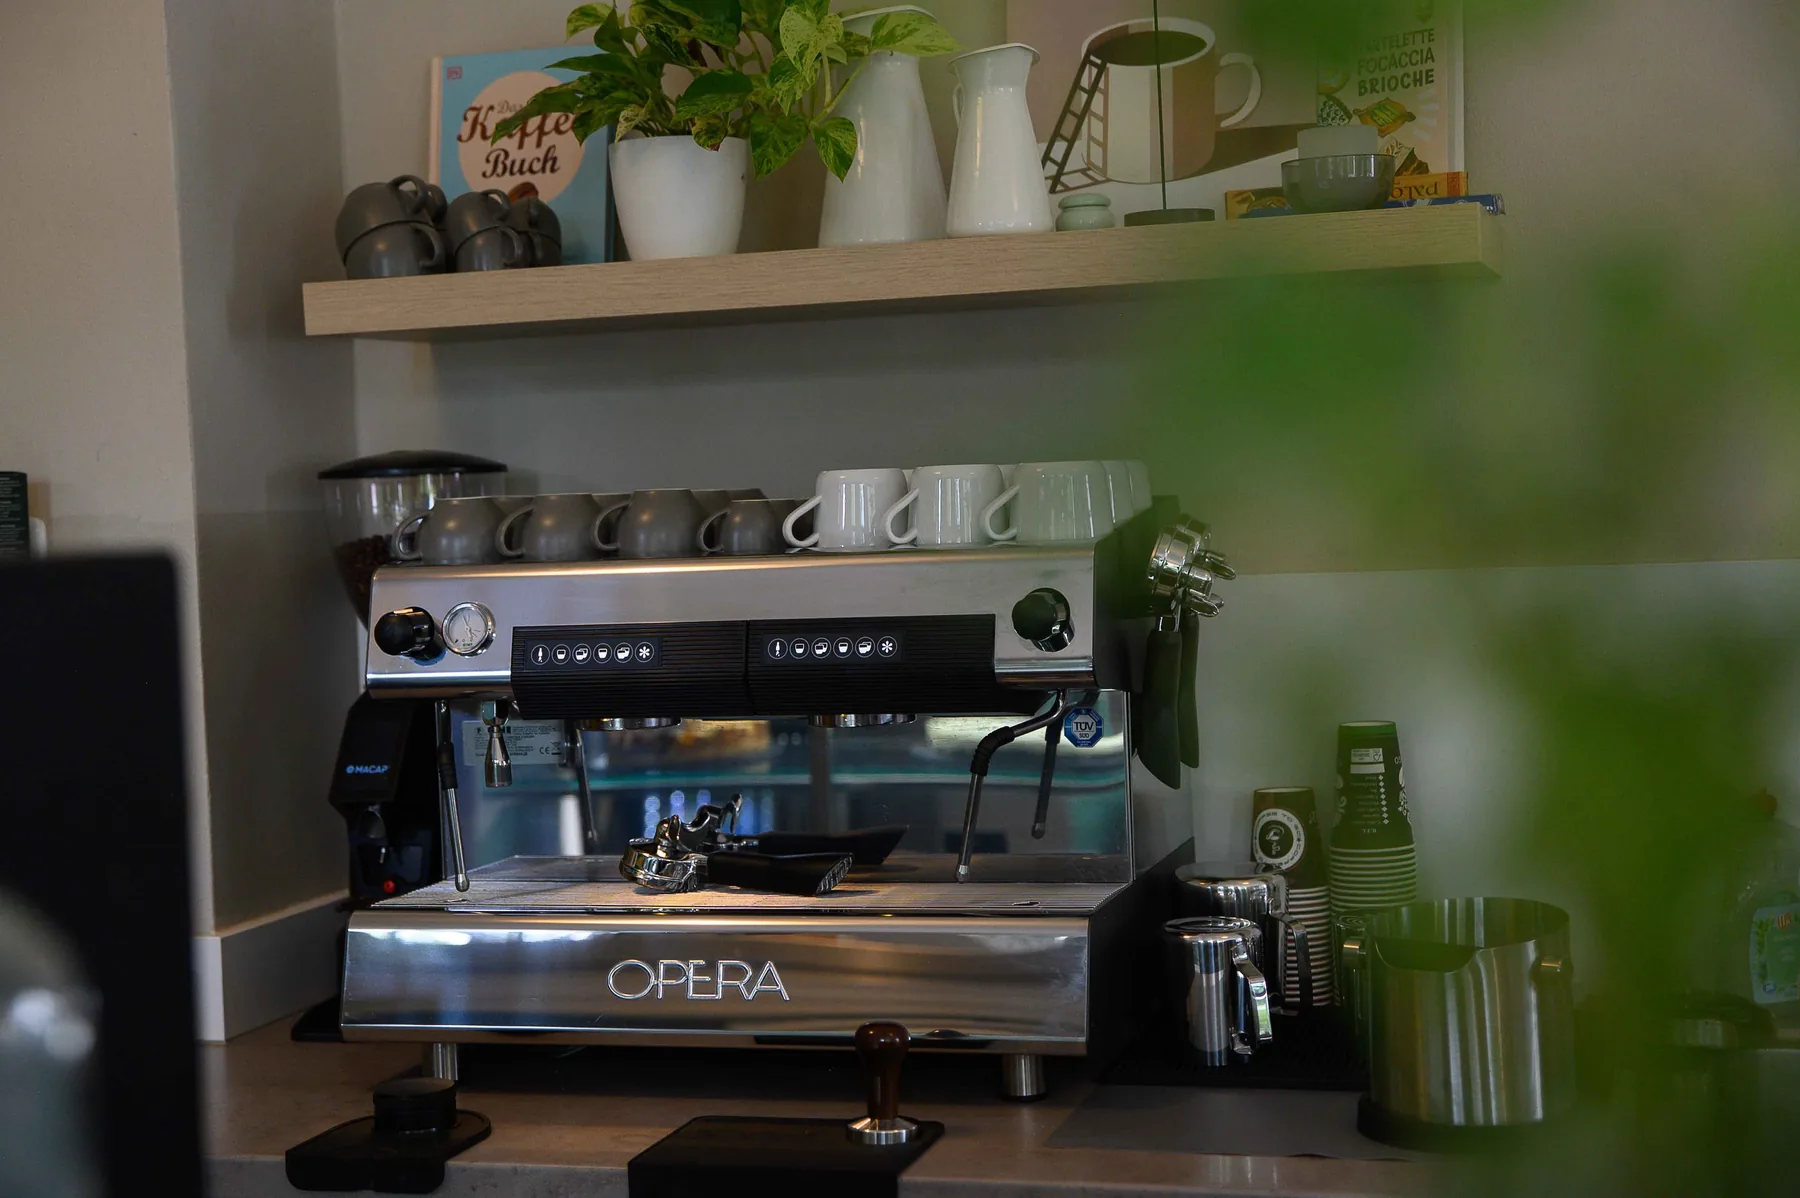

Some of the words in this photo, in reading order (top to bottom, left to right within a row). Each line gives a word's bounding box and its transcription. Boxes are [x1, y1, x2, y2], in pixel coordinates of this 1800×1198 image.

[1357, 46, 1436, 76] FOCACCIA
[1358, 68, 1435, 97] BRIOCHE
[482, 144, 560, 179] Buch
[355, 764, 390, 774] MACAP
[607, 959, 790, 1001] OPERA
